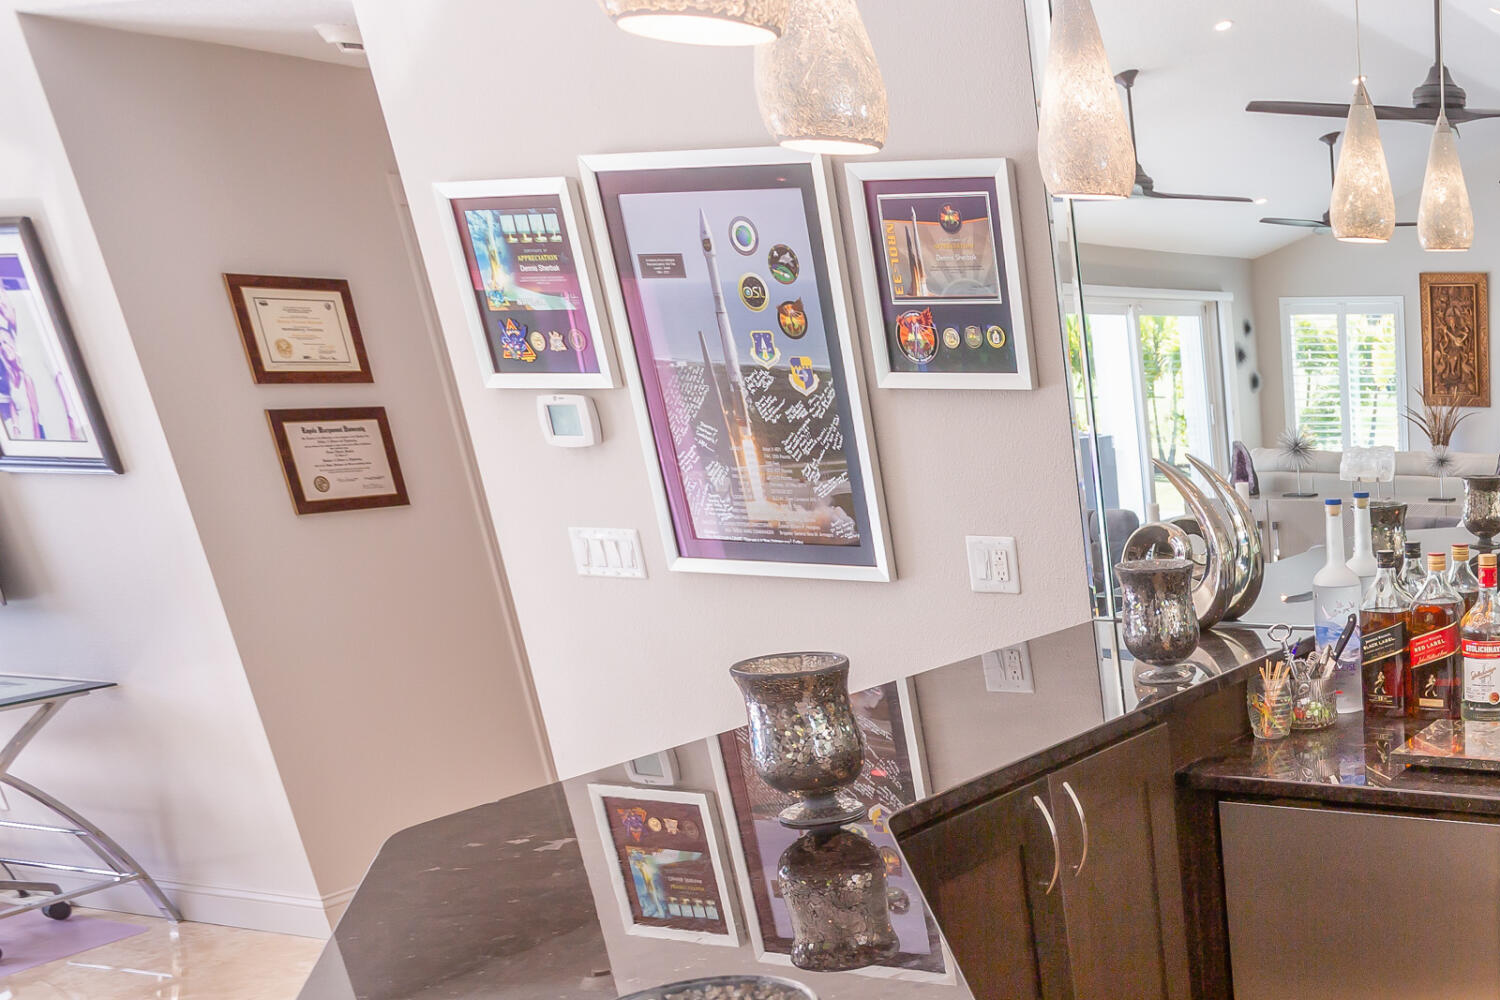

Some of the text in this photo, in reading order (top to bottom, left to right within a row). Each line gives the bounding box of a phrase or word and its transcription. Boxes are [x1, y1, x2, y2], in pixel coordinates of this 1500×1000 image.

[886, 223, 904, 295] NROL-33
[1414, 639, 1446, 653] RED LABEL
